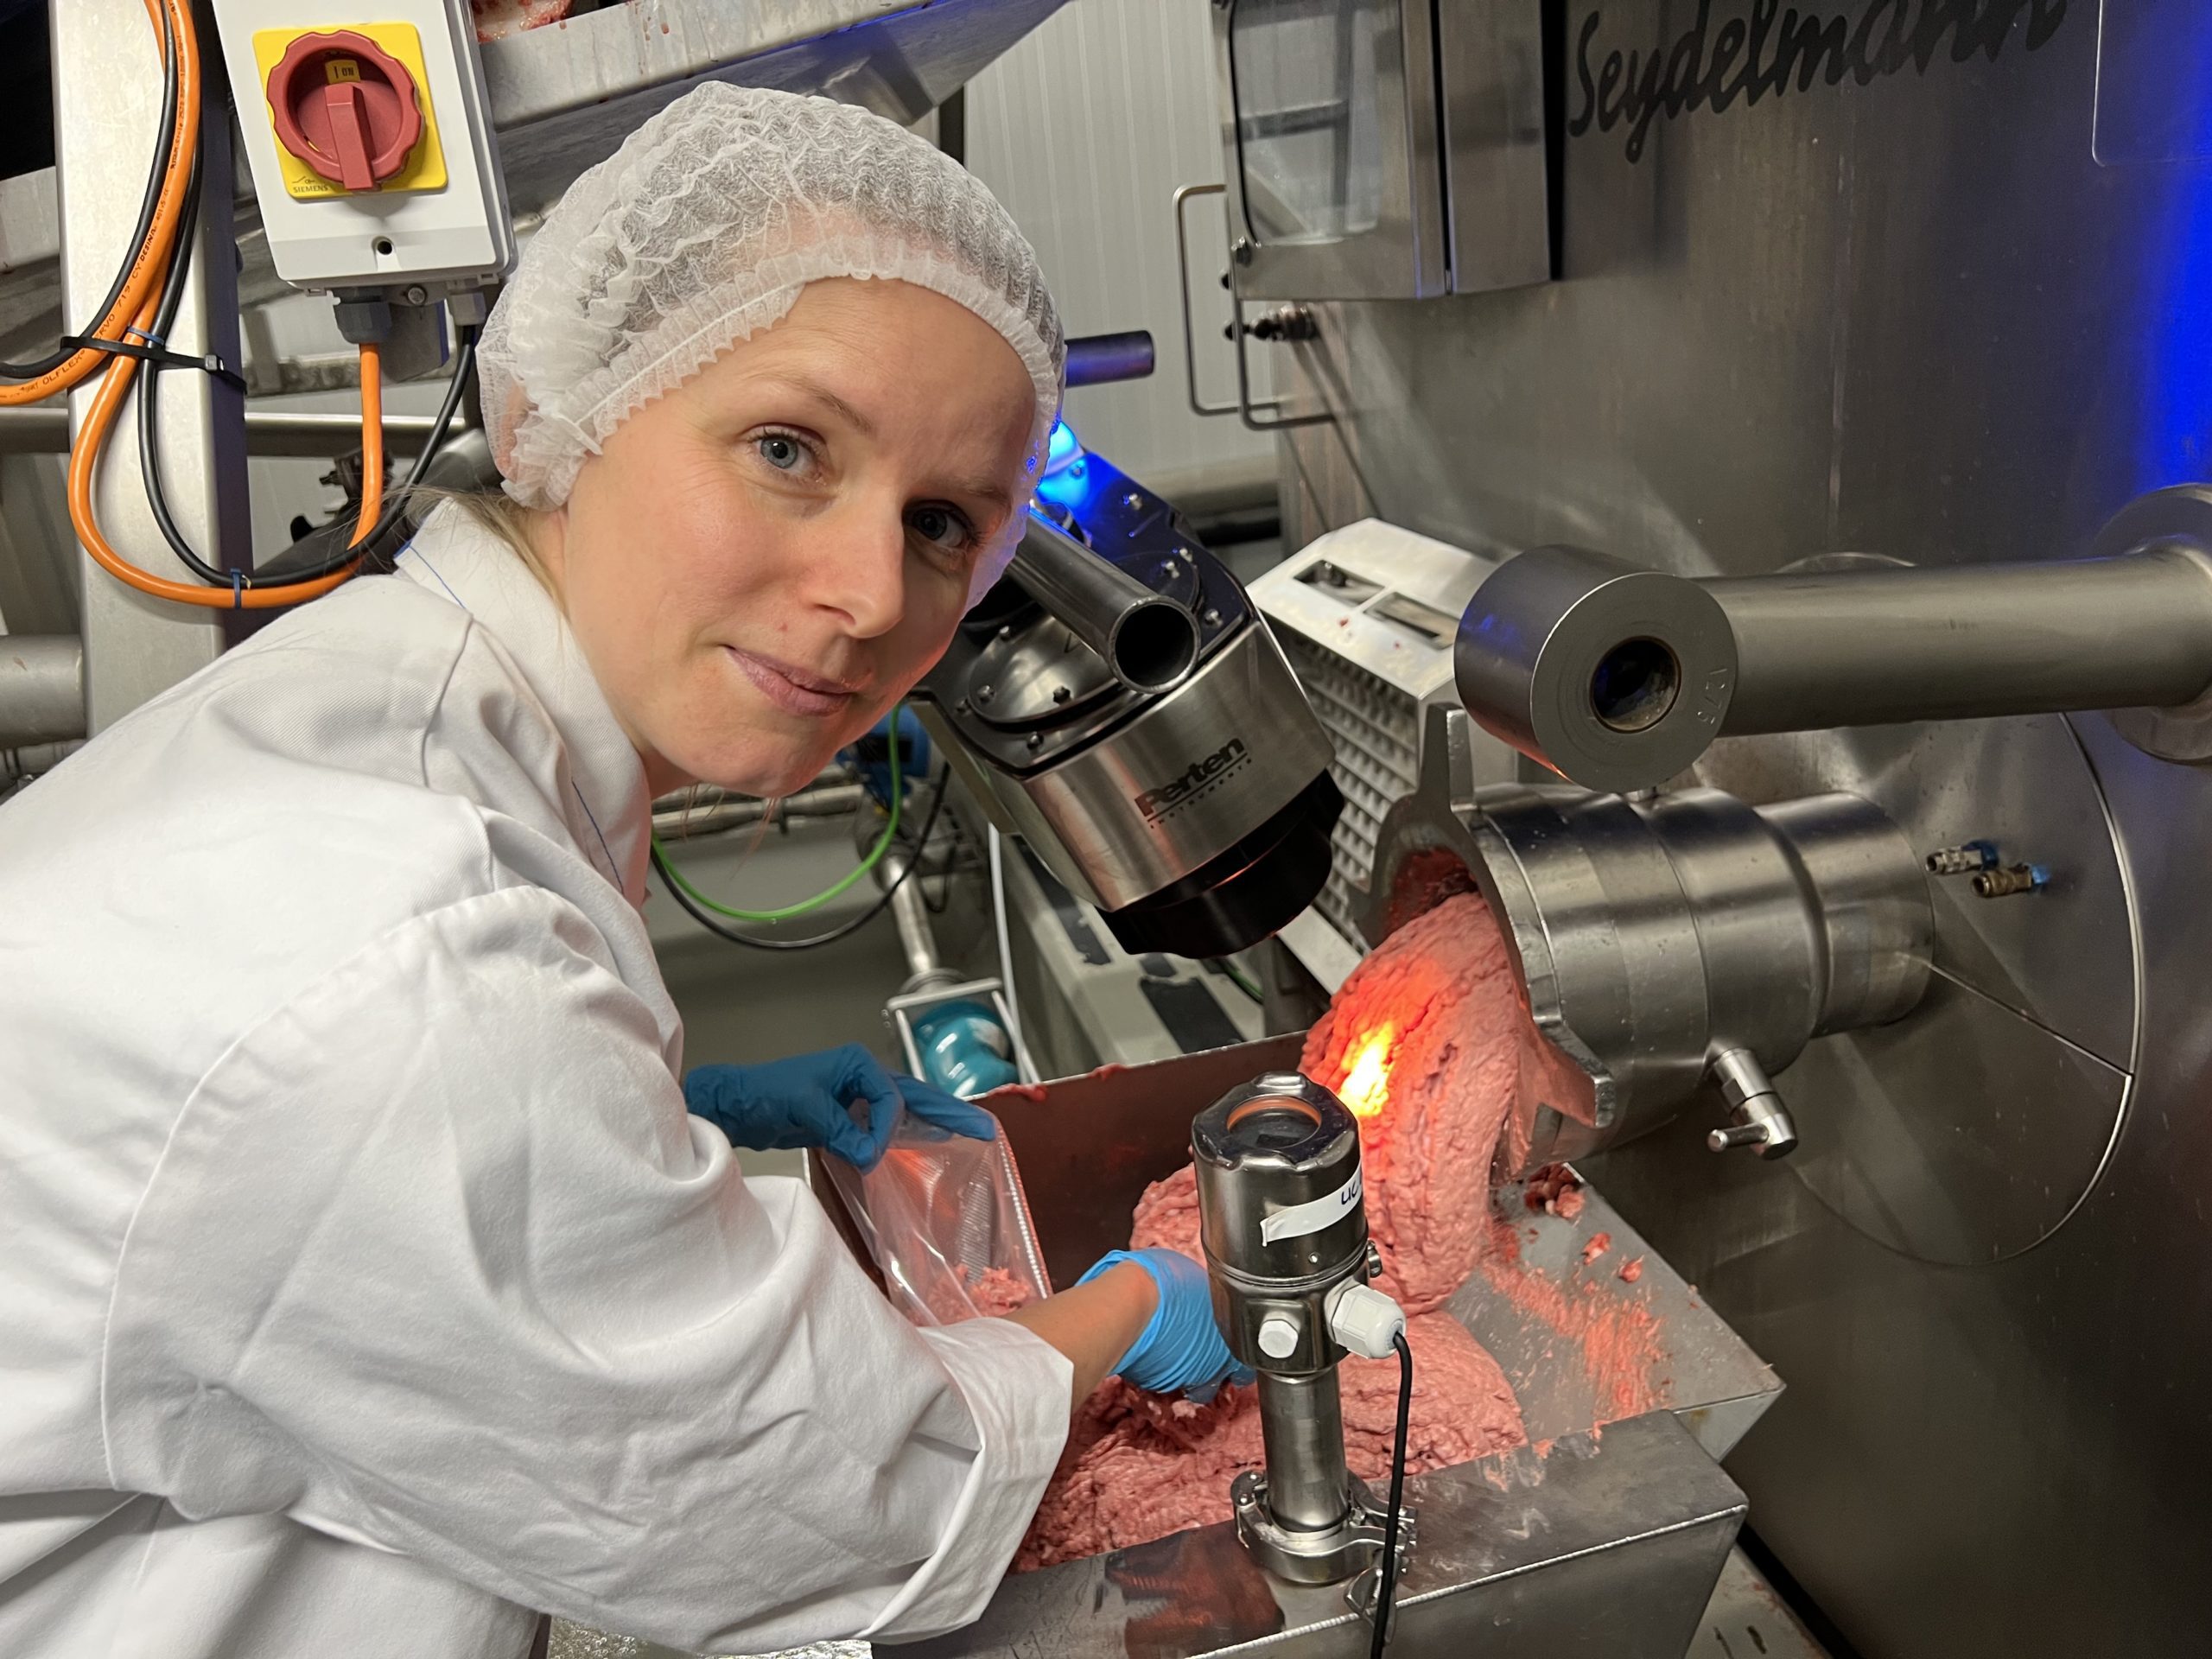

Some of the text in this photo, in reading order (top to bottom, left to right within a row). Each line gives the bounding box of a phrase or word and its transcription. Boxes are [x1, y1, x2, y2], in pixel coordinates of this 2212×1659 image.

[1567, 0, 2067, 164] Seydelmann
[293, 185, 329, 194] SIEMENS
[95, 313, 116, 340] ERVO
[1135, 738, 1245, 817] Perten
